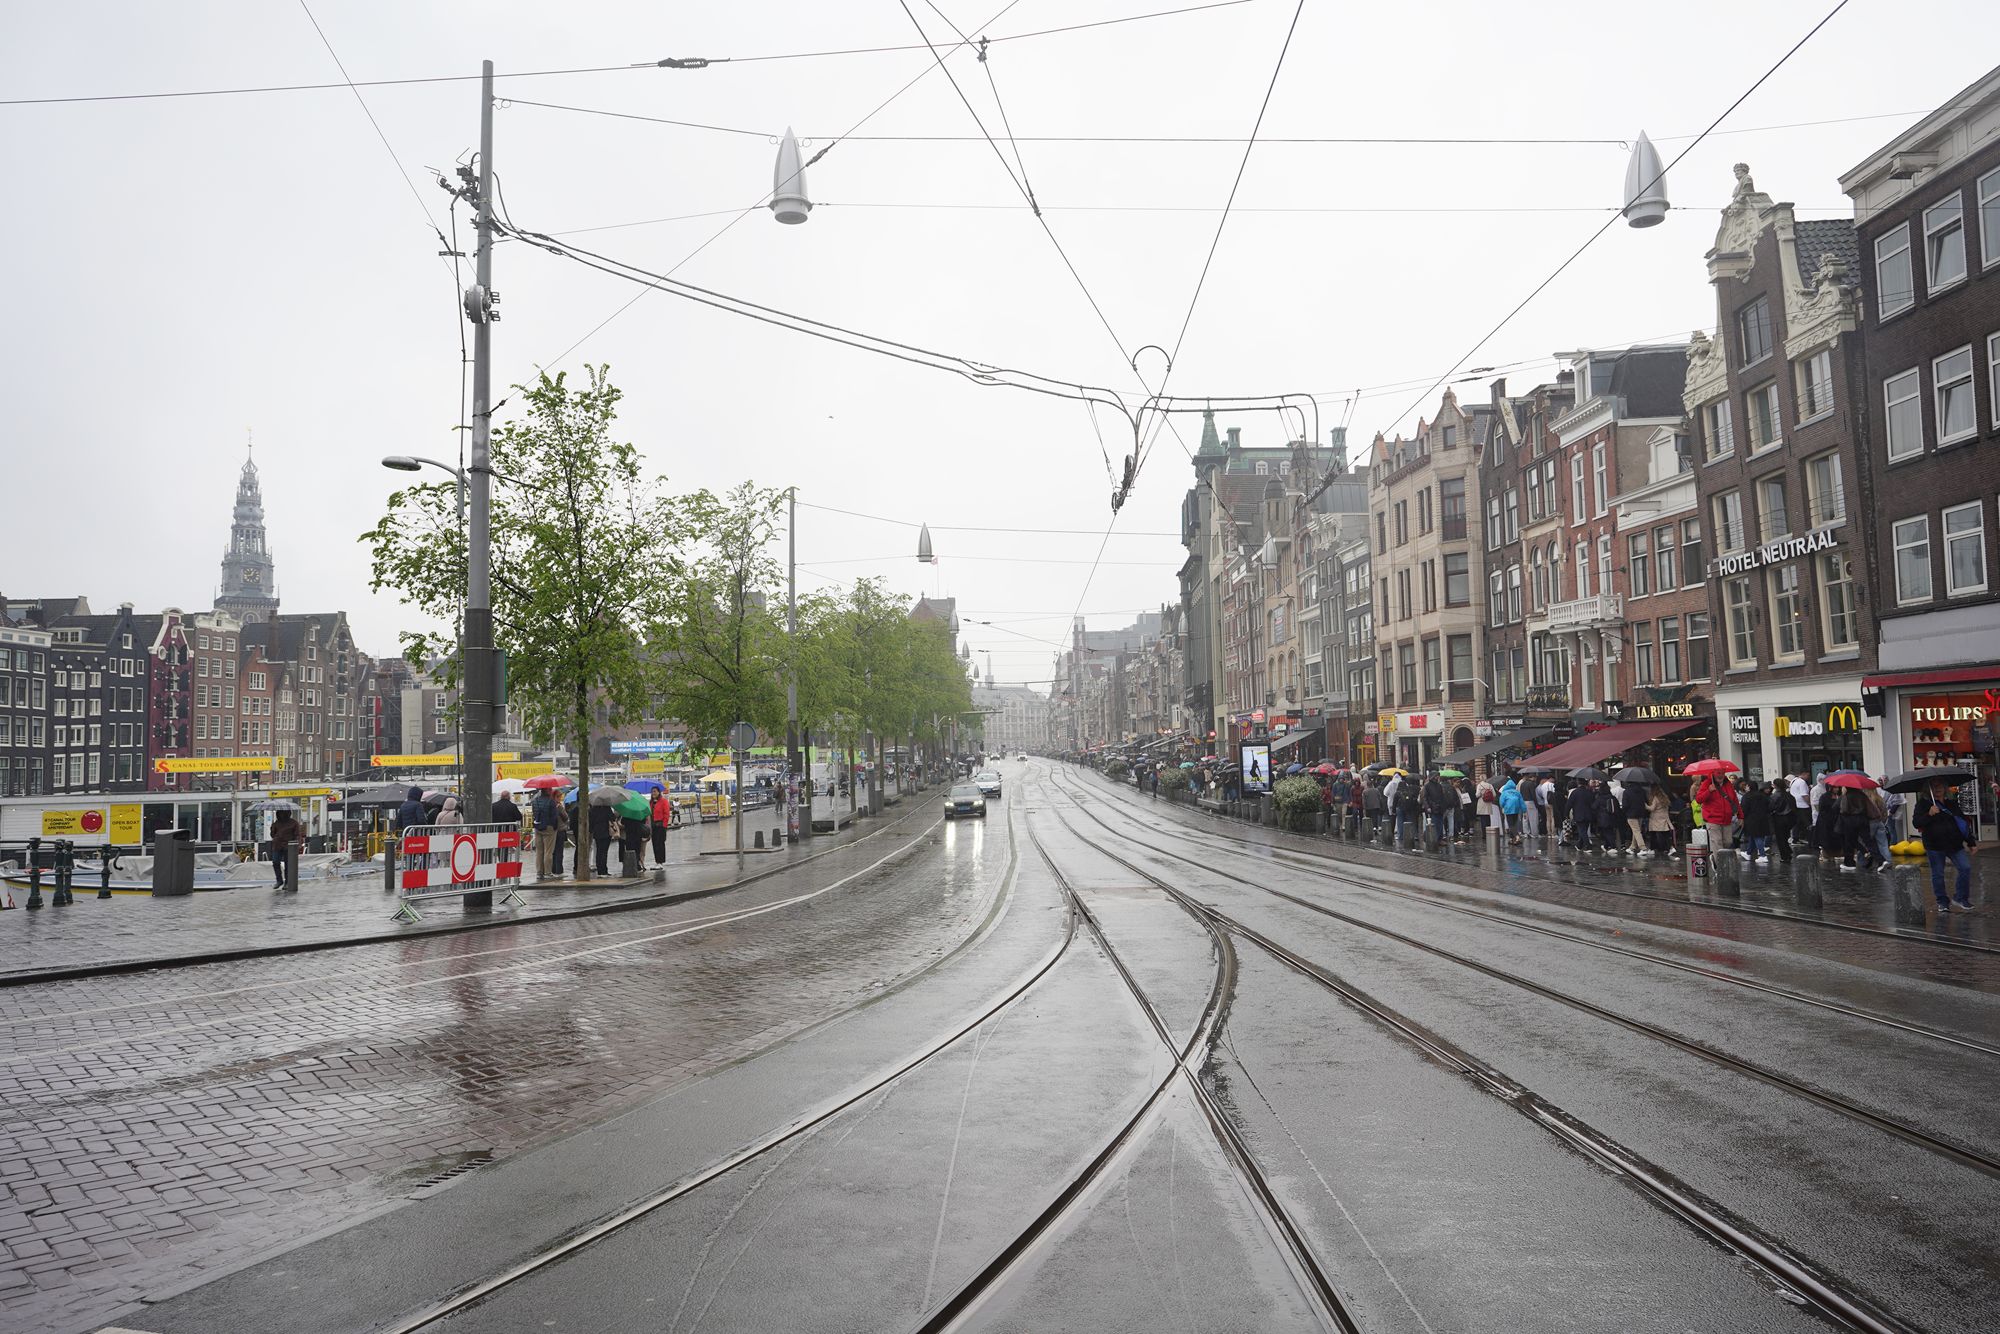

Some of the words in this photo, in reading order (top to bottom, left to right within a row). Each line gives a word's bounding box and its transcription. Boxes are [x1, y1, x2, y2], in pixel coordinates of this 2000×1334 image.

[1719, 551, 1760, 577] HOTEL
[1762, 529, 1838, 566] NEUTRAAL
[1650, 703, 1694, 718] BURGER
[1912, 706, 1983, 721] TULIPS
[1731, 715, 1758, 730] HOTEL
[1732, 732, 1760, 743] NEUTRAAL
